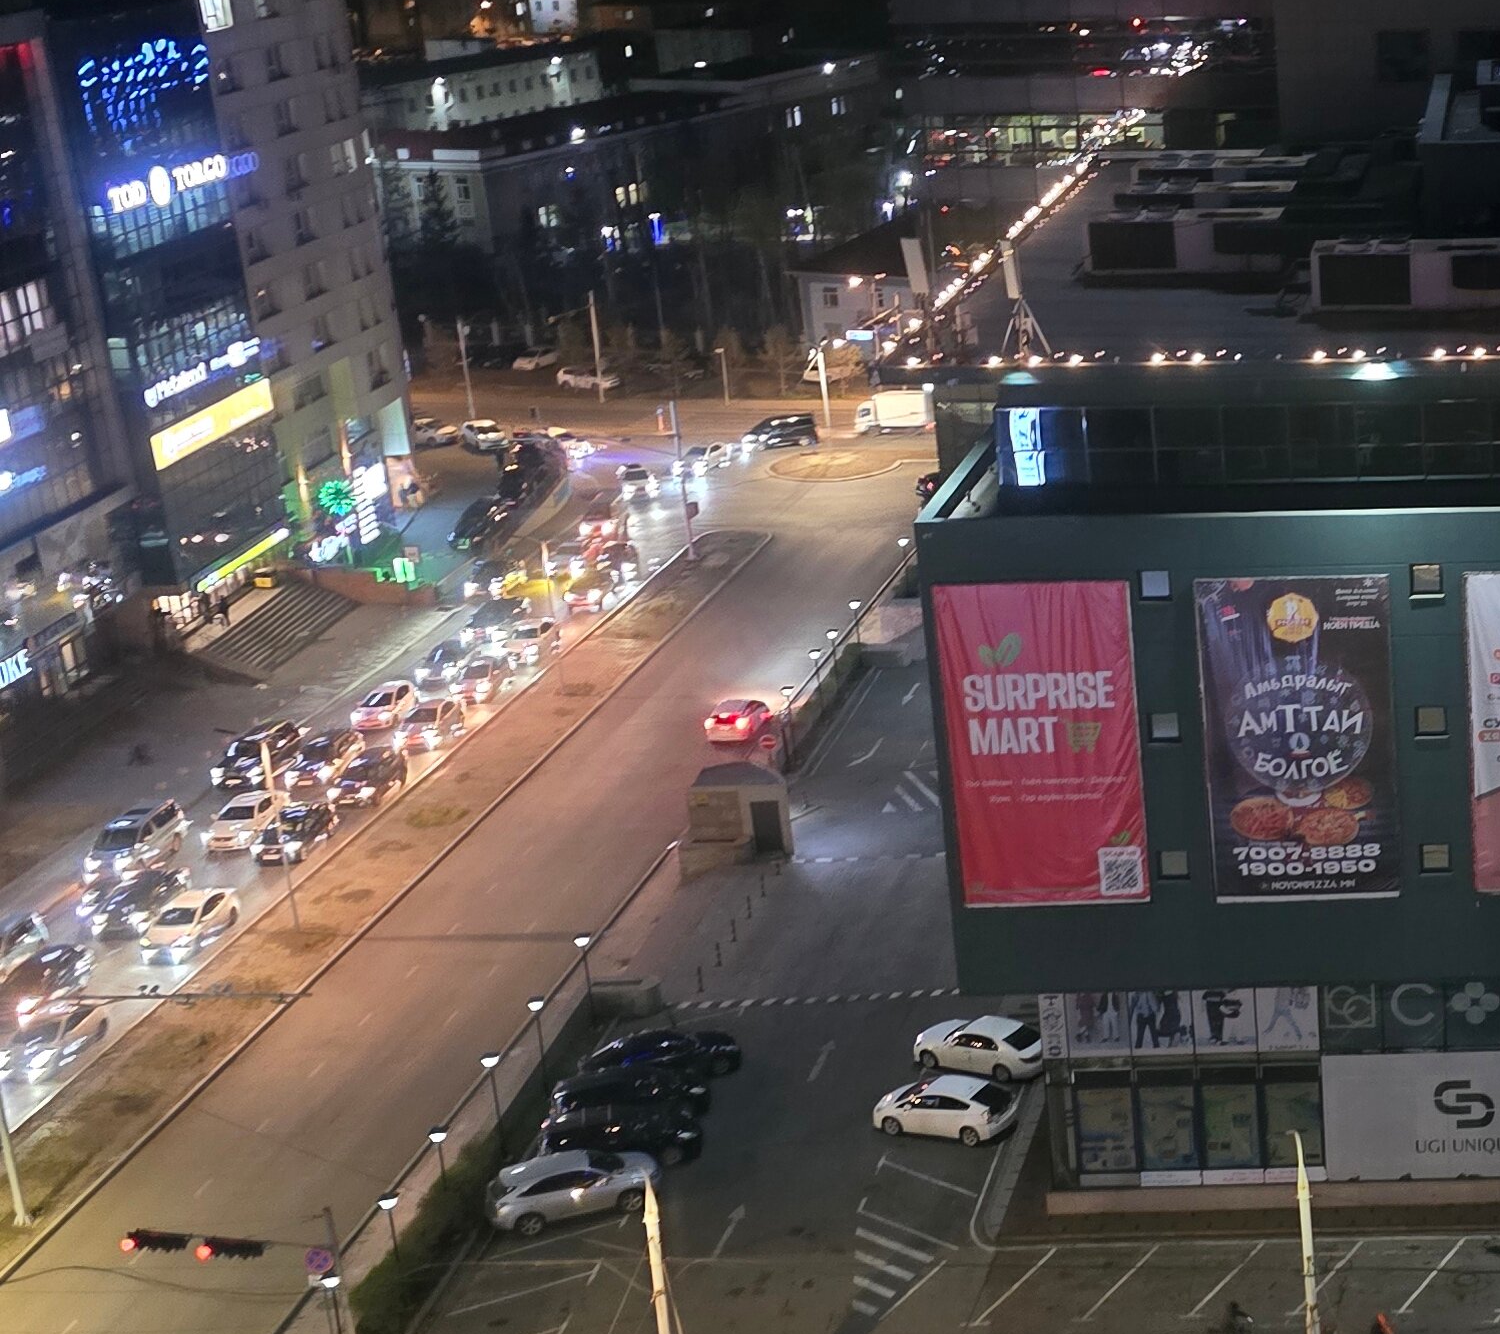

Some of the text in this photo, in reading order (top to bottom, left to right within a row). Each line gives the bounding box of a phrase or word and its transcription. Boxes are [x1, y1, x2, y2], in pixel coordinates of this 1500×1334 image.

[963, 670, 1116, 713] SURPRISE
[968, 717, 1059, 756] MART
[1232, 842, 1382, 861] 7007-8888
[1238, 858, 1377, 877] 1900-1950
[1415, 1138, 1446, 1155] UGI
